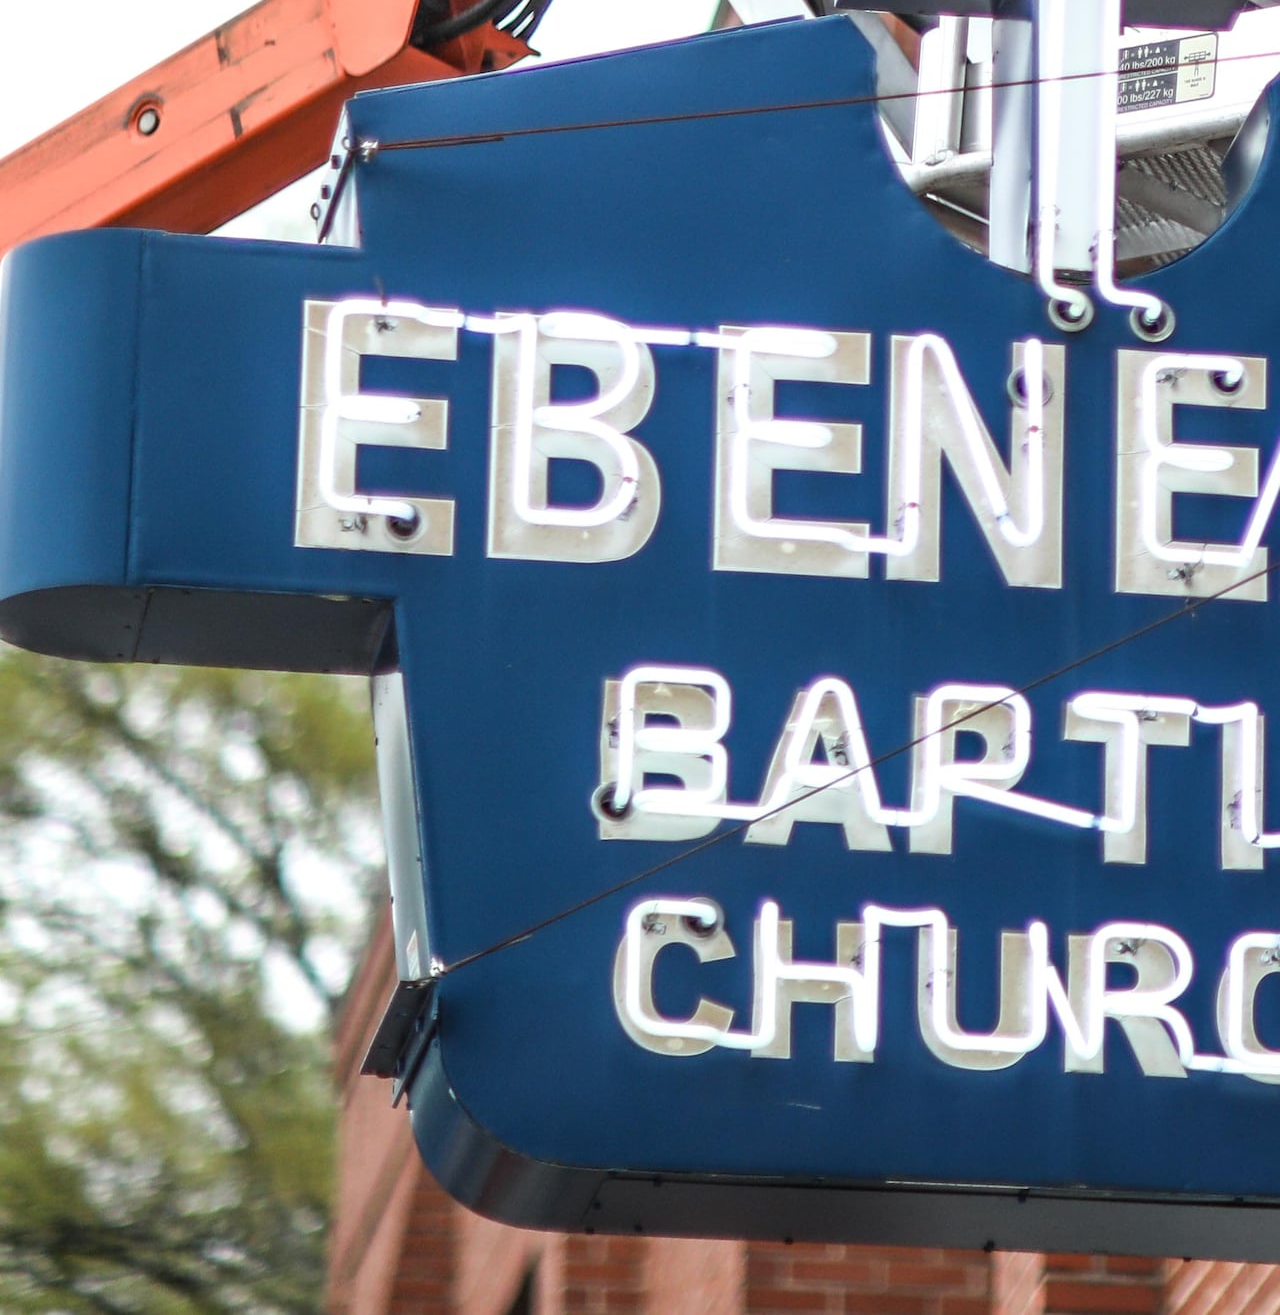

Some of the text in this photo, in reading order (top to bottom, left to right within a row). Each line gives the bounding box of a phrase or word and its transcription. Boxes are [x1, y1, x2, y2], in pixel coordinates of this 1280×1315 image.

[1132, 56, 1163, 69] lbs/200
[1130, 89, 1160, 102] lbs/227
[1163, 88, 1174, 99] kg
